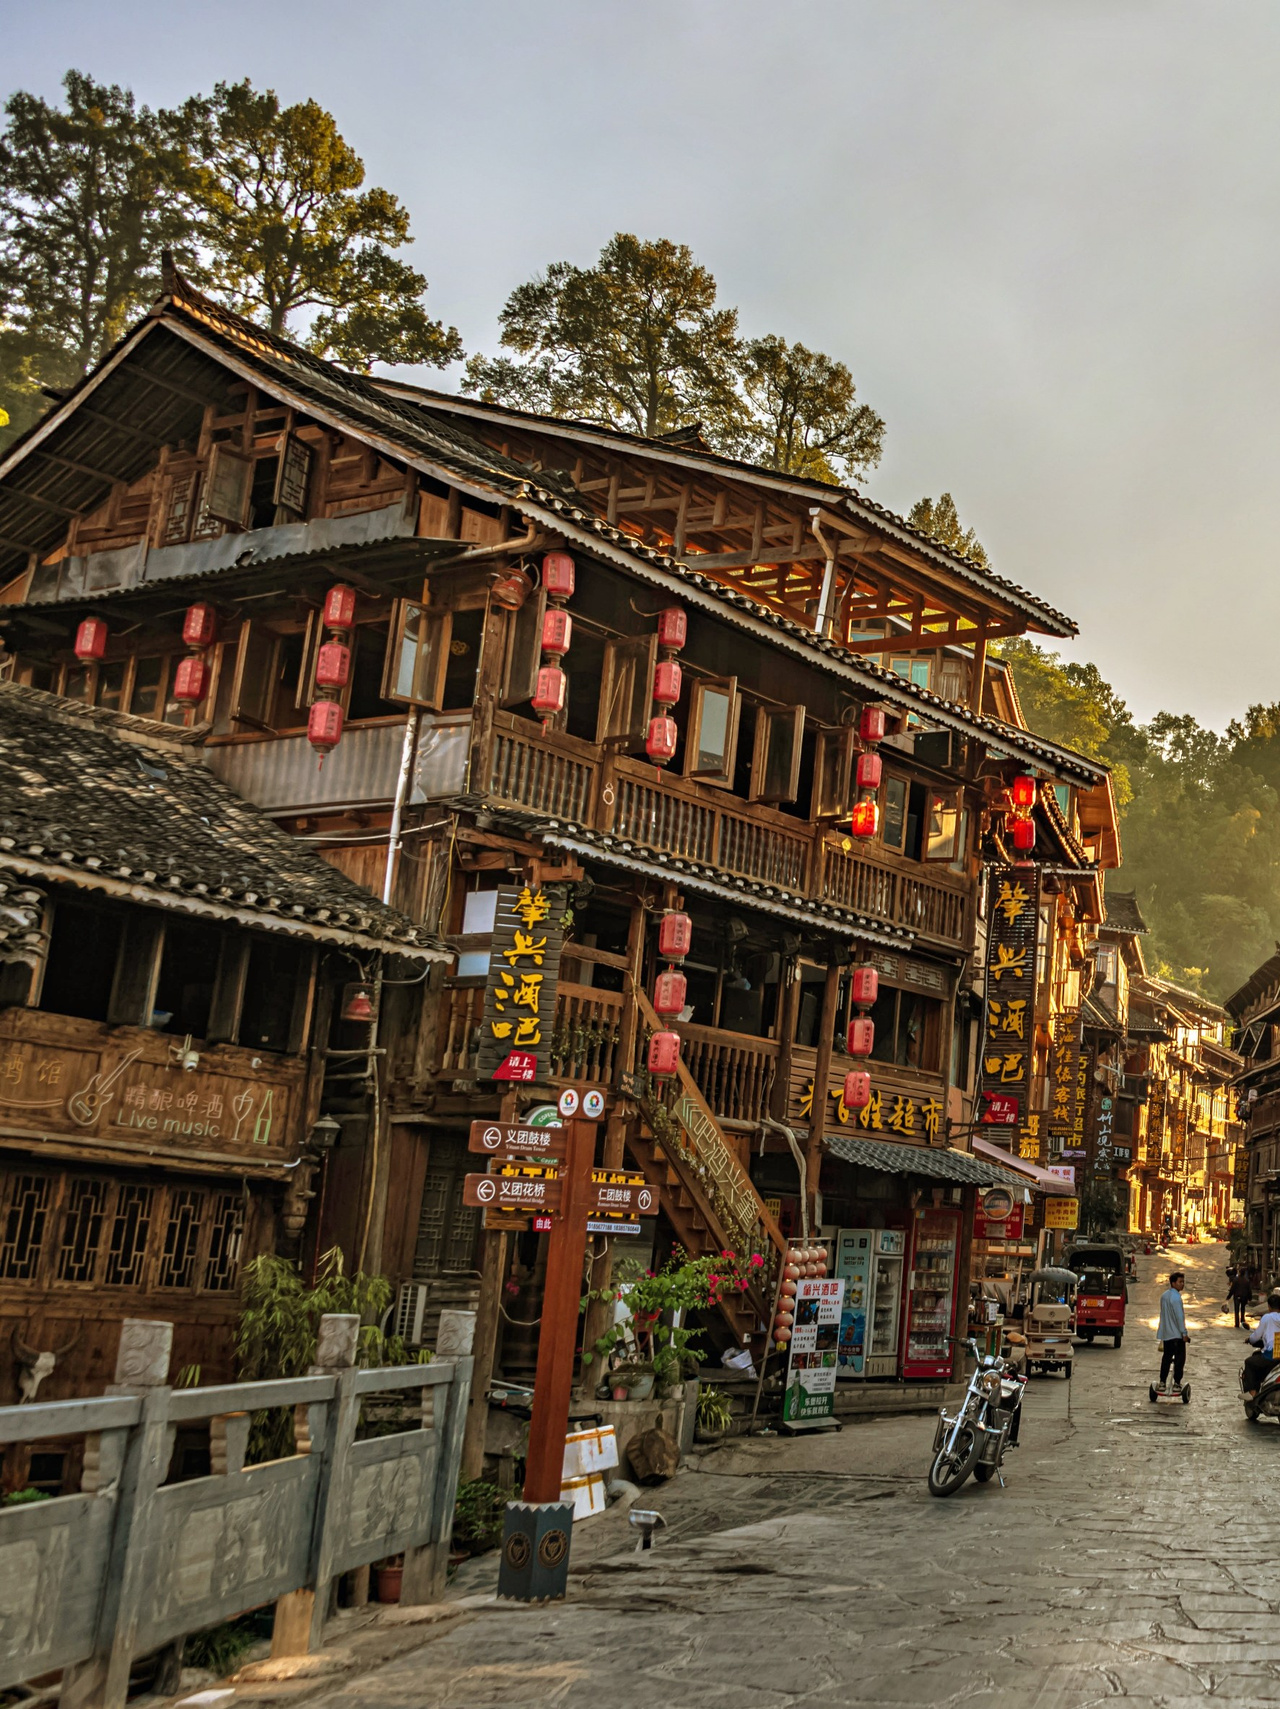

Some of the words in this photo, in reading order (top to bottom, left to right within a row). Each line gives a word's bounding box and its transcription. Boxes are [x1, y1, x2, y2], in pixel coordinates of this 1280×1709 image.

[492, 887, 551, 1046] 肇兴酒吧
[985, 881, 1030, 1083] 肇兴酒吧
[509, 1056, 531, 1068] 请上
[511, 1069, 534, 1080] 二楼
[125, 1082, 223, 1119] 精酿啤酒
[992, 1102, 1011, 1113] 请上
[116, 1108, 158, 1130] Live
[163, 1114, 221, 1138] music
[996, 1112, 1015, 1123] 二楼
[505, 1129, 551, 1146] 义团鼓楼
[499, 1181, 546, 1197] 义团花桥
[598, 1187, 631, 1203] 仁团鼓楼
